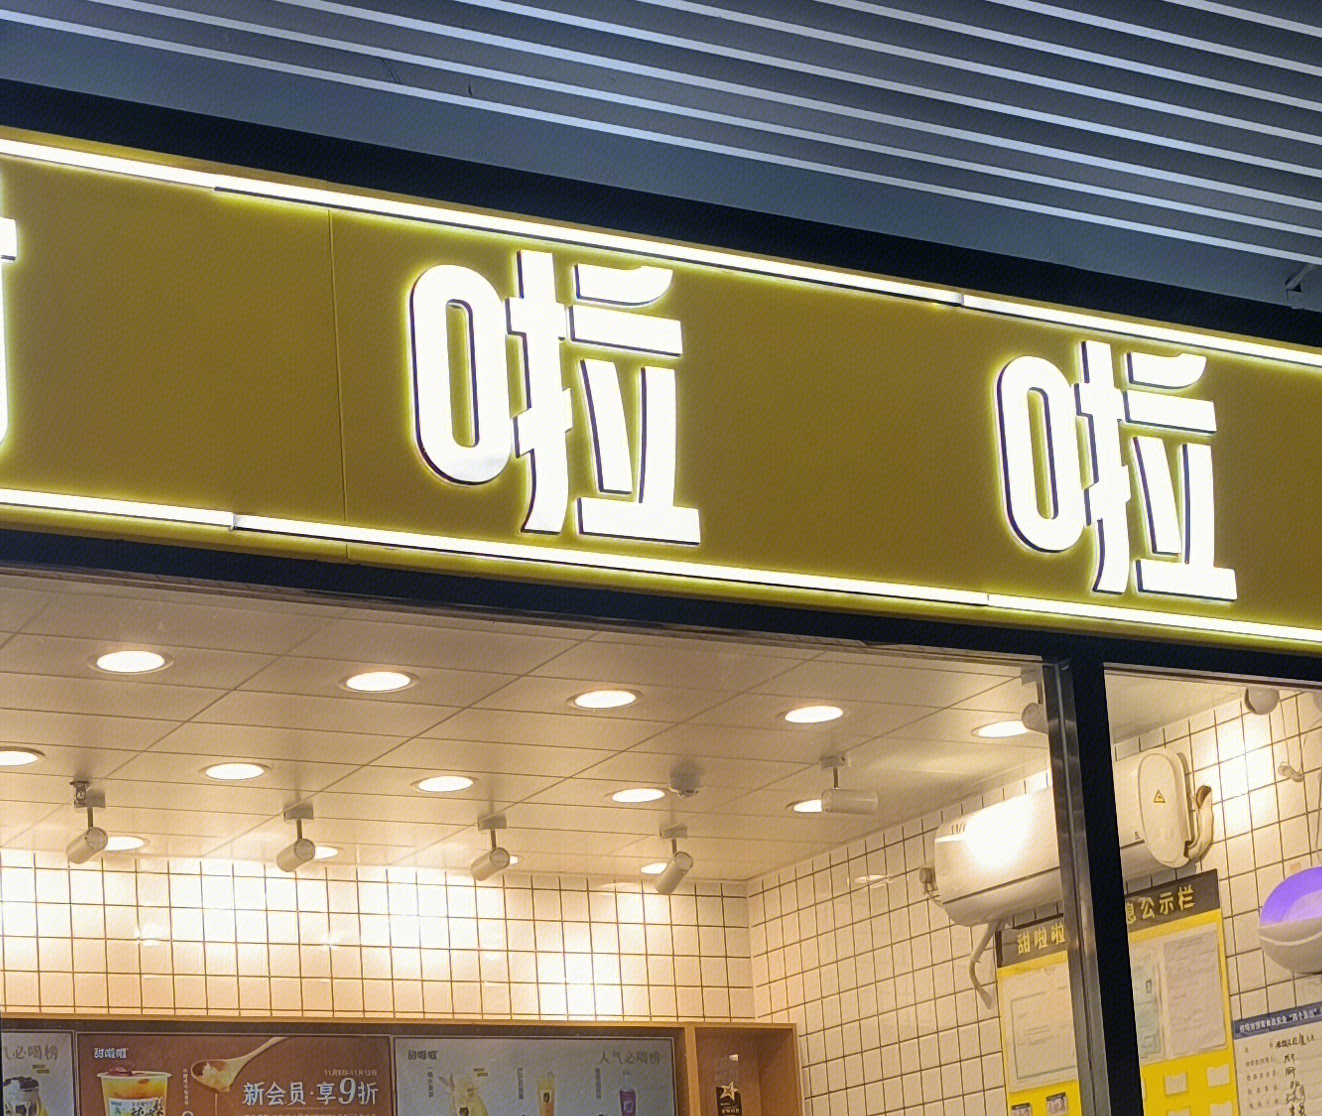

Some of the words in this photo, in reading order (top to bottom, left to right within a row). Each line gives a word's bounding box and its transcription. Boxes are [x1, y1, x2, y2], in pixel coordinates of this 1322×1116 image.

[1016, 922, 1066, 957] 甜啦啦
[5, 1045, 59, 1061] 必喝榜
